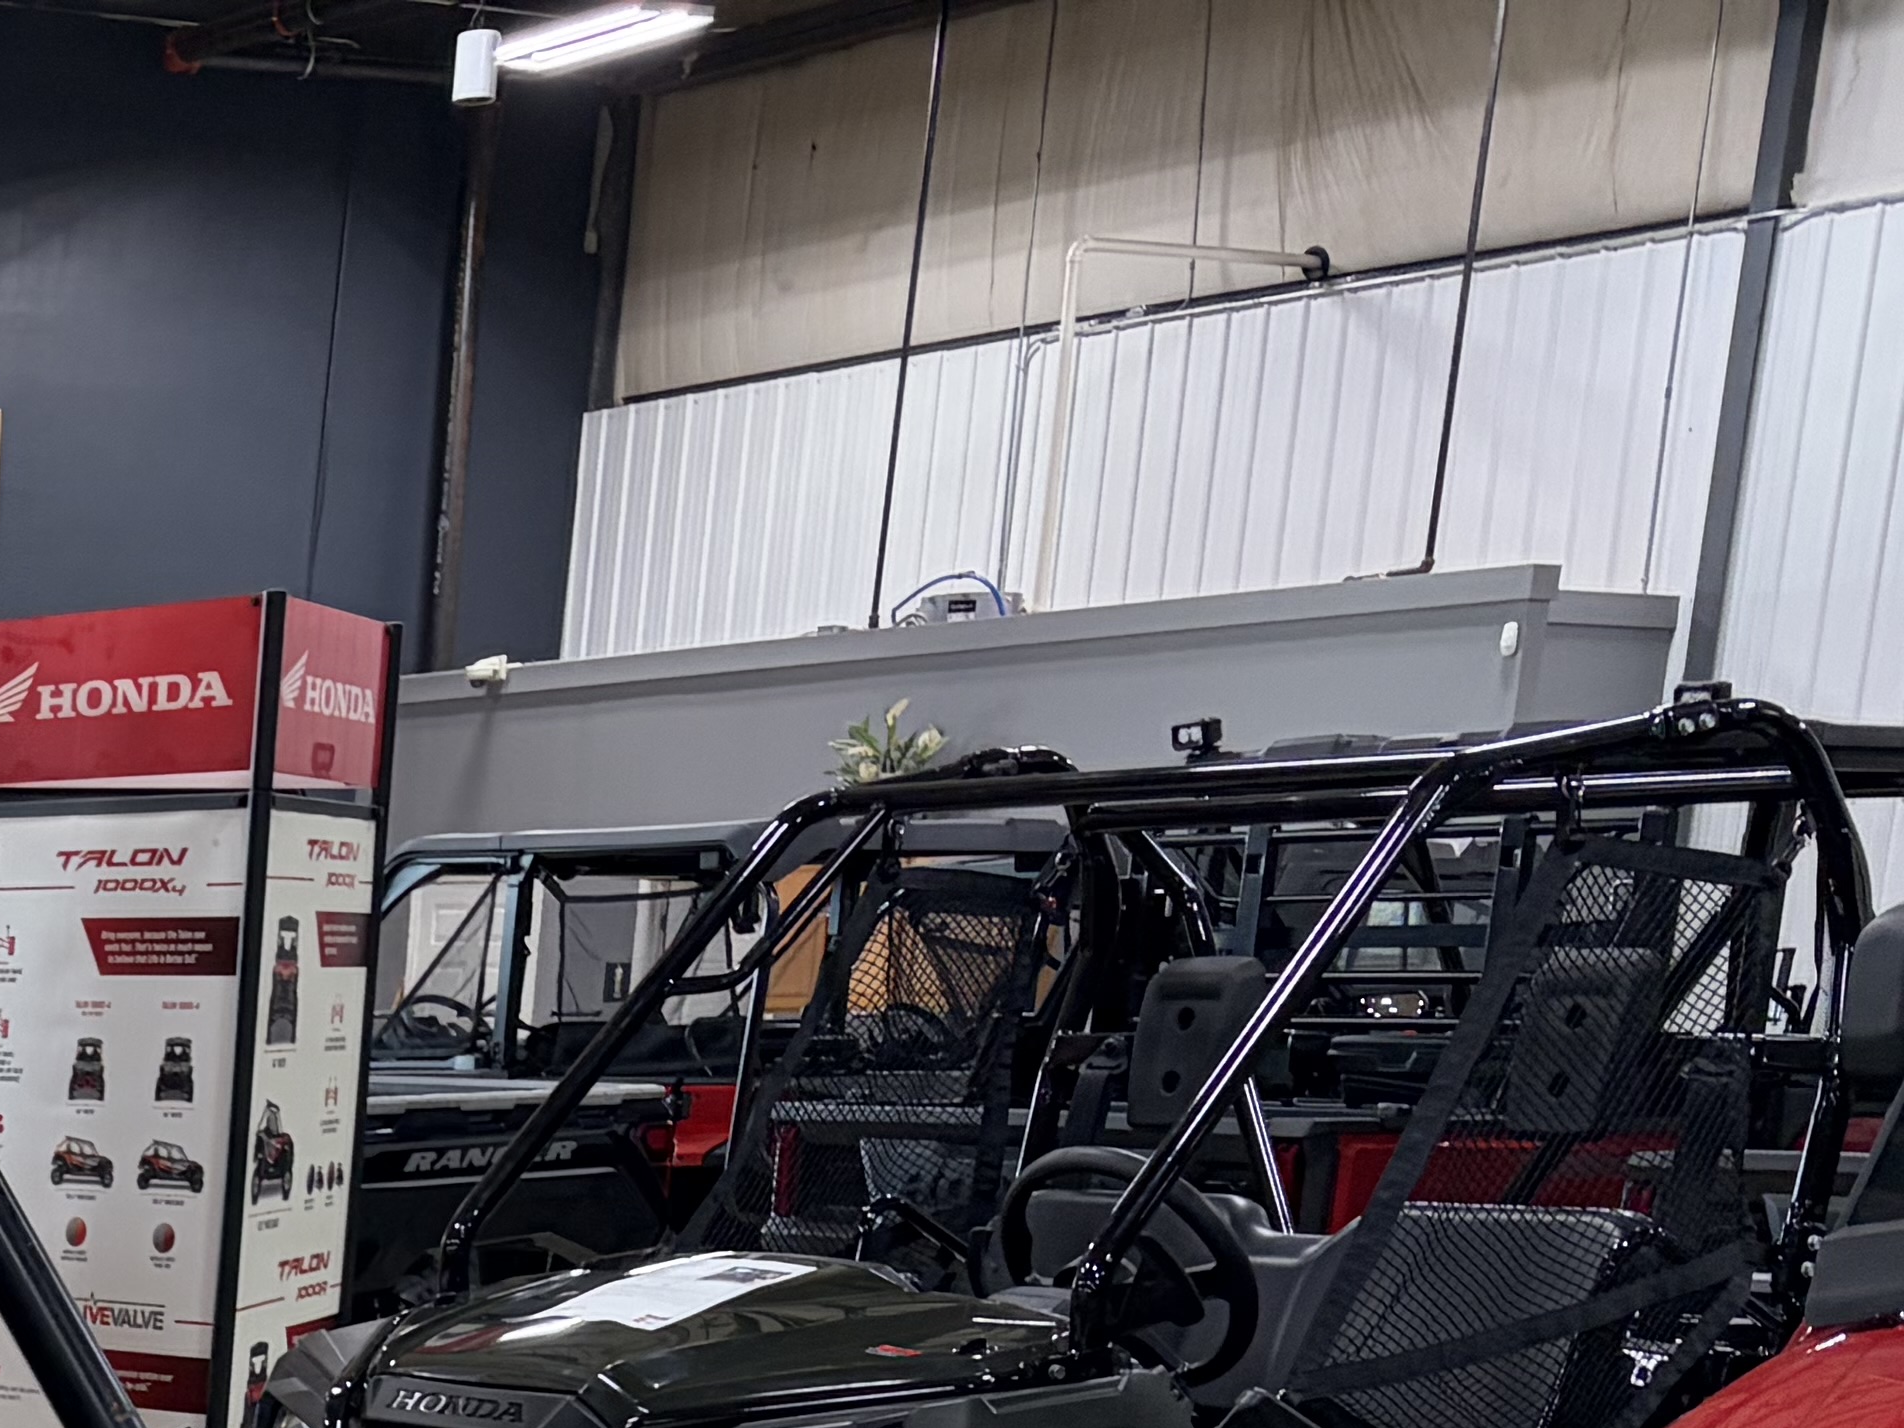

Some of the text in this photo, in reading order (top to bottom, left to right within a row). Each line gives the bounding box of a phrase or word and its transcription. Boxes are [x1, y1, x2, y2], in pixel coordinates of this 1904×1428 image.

[35, 670, 233, 721] HONDA
[303, 673, 376, 724] HONDA
[55, 845, 190, 872] TALON
[306, 838, 360, 862] TALON
[403, 1140, 578, 1173] RANR
[278, 1250, 331, 1281] TALON
[83, 1304, 165, 1331] IVEVALVE
[387, 1389, 525, 1423] HONDA
